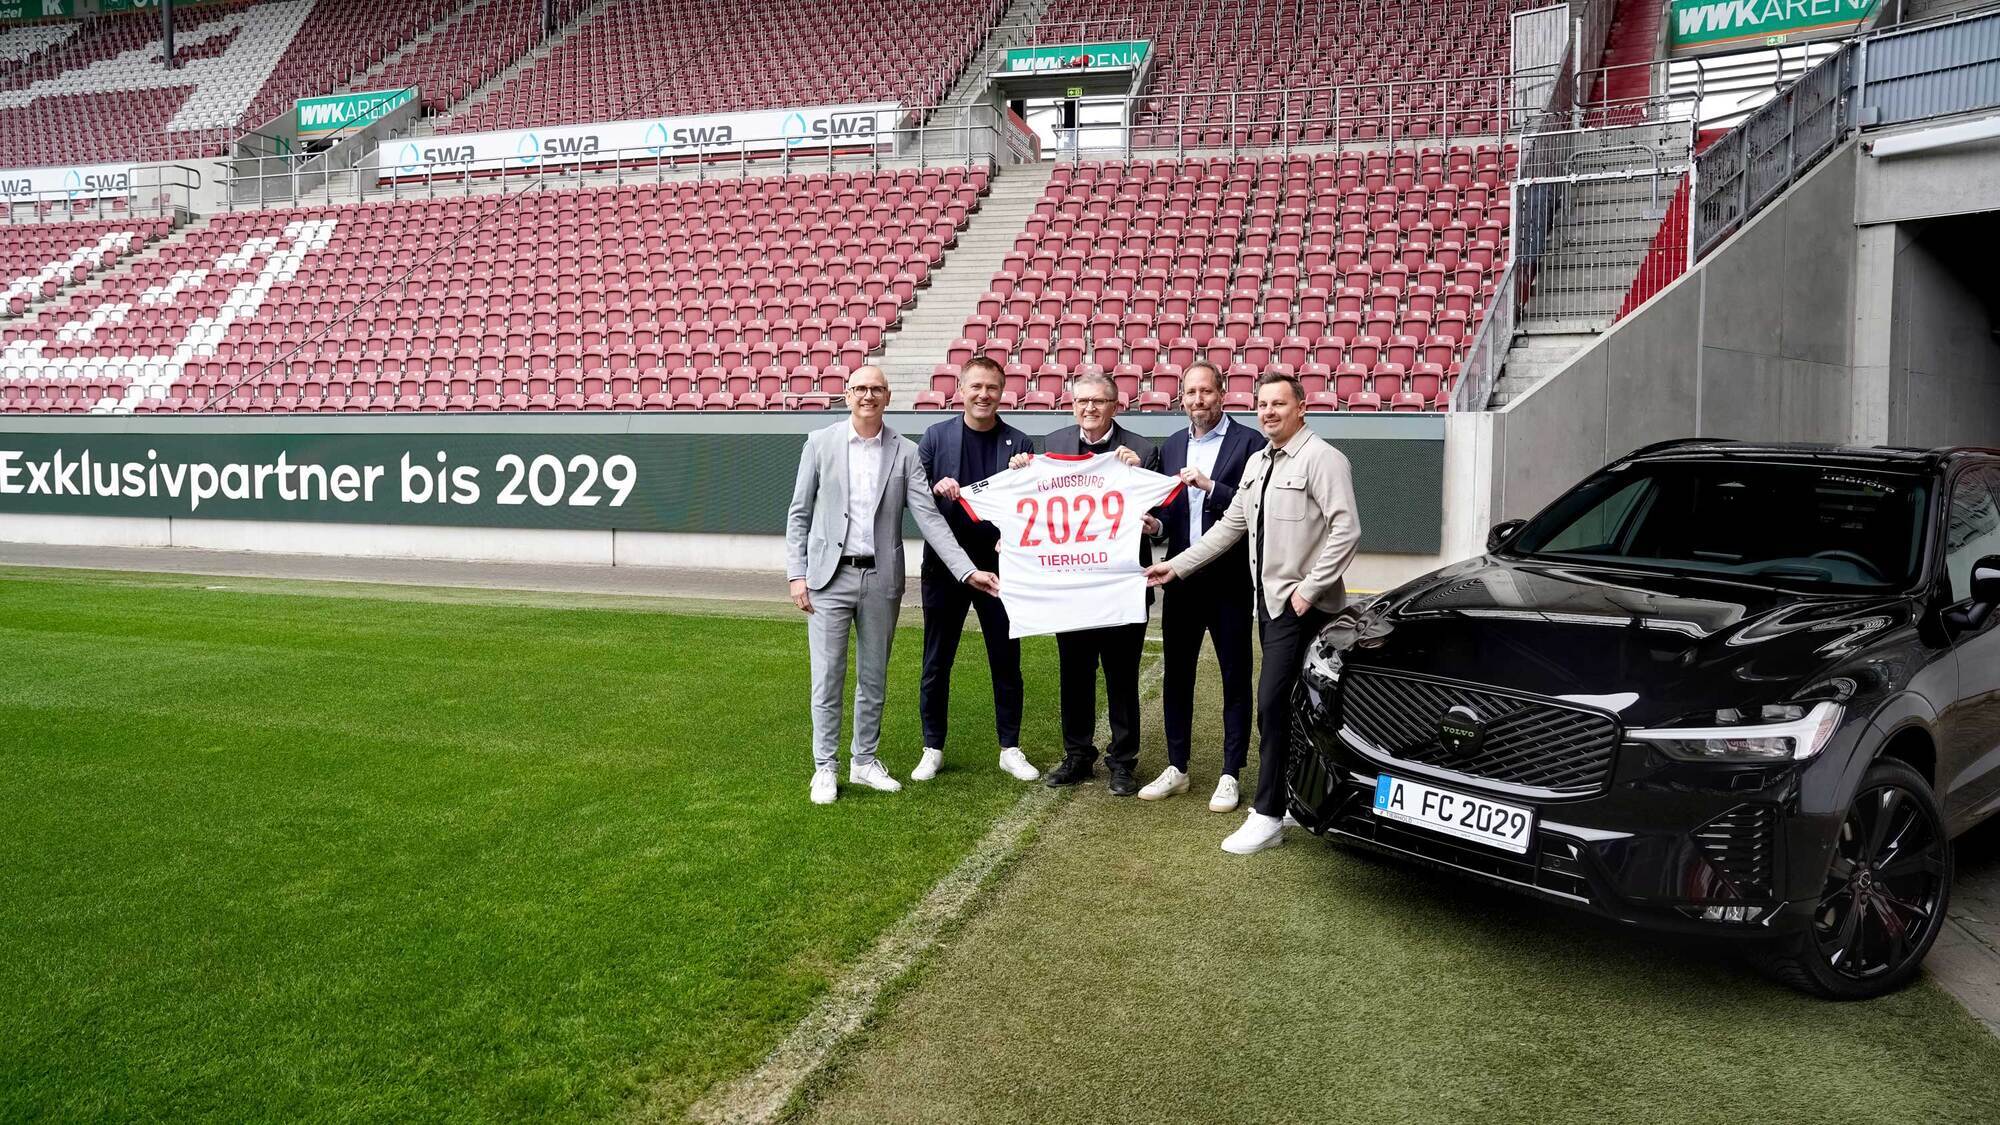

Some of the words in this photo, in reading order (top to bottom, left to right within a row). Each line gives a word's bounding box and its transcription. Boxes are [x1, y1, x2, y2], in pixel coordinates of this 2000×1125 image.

[1679, 0, 1867, 35] WWKARE
[673, 125, 732, 149] swa
[812, 115, 875, 141] swa
[424, 145, 474, 167] swa
[544, 135, 599, 158] swa
[85, 173, 128, 193] swa
[0, 449, 384, 512] Exklusivpartner
[400, 450, 480, 504] bis
[496, 454, 637, 506] 2029
[1051, 475, 1105, 489] AUGSBURG
[1016, 490, 1125, 547] 2029
[1038, 552, 1108, 567] TIERHOLD
[1443, 726, 1475, 738] VOLVO
[1390, 783, 1404, 811] A
[1421, 790, 1454, 822] FC
[1459, 800, 1526, 840] 2029
